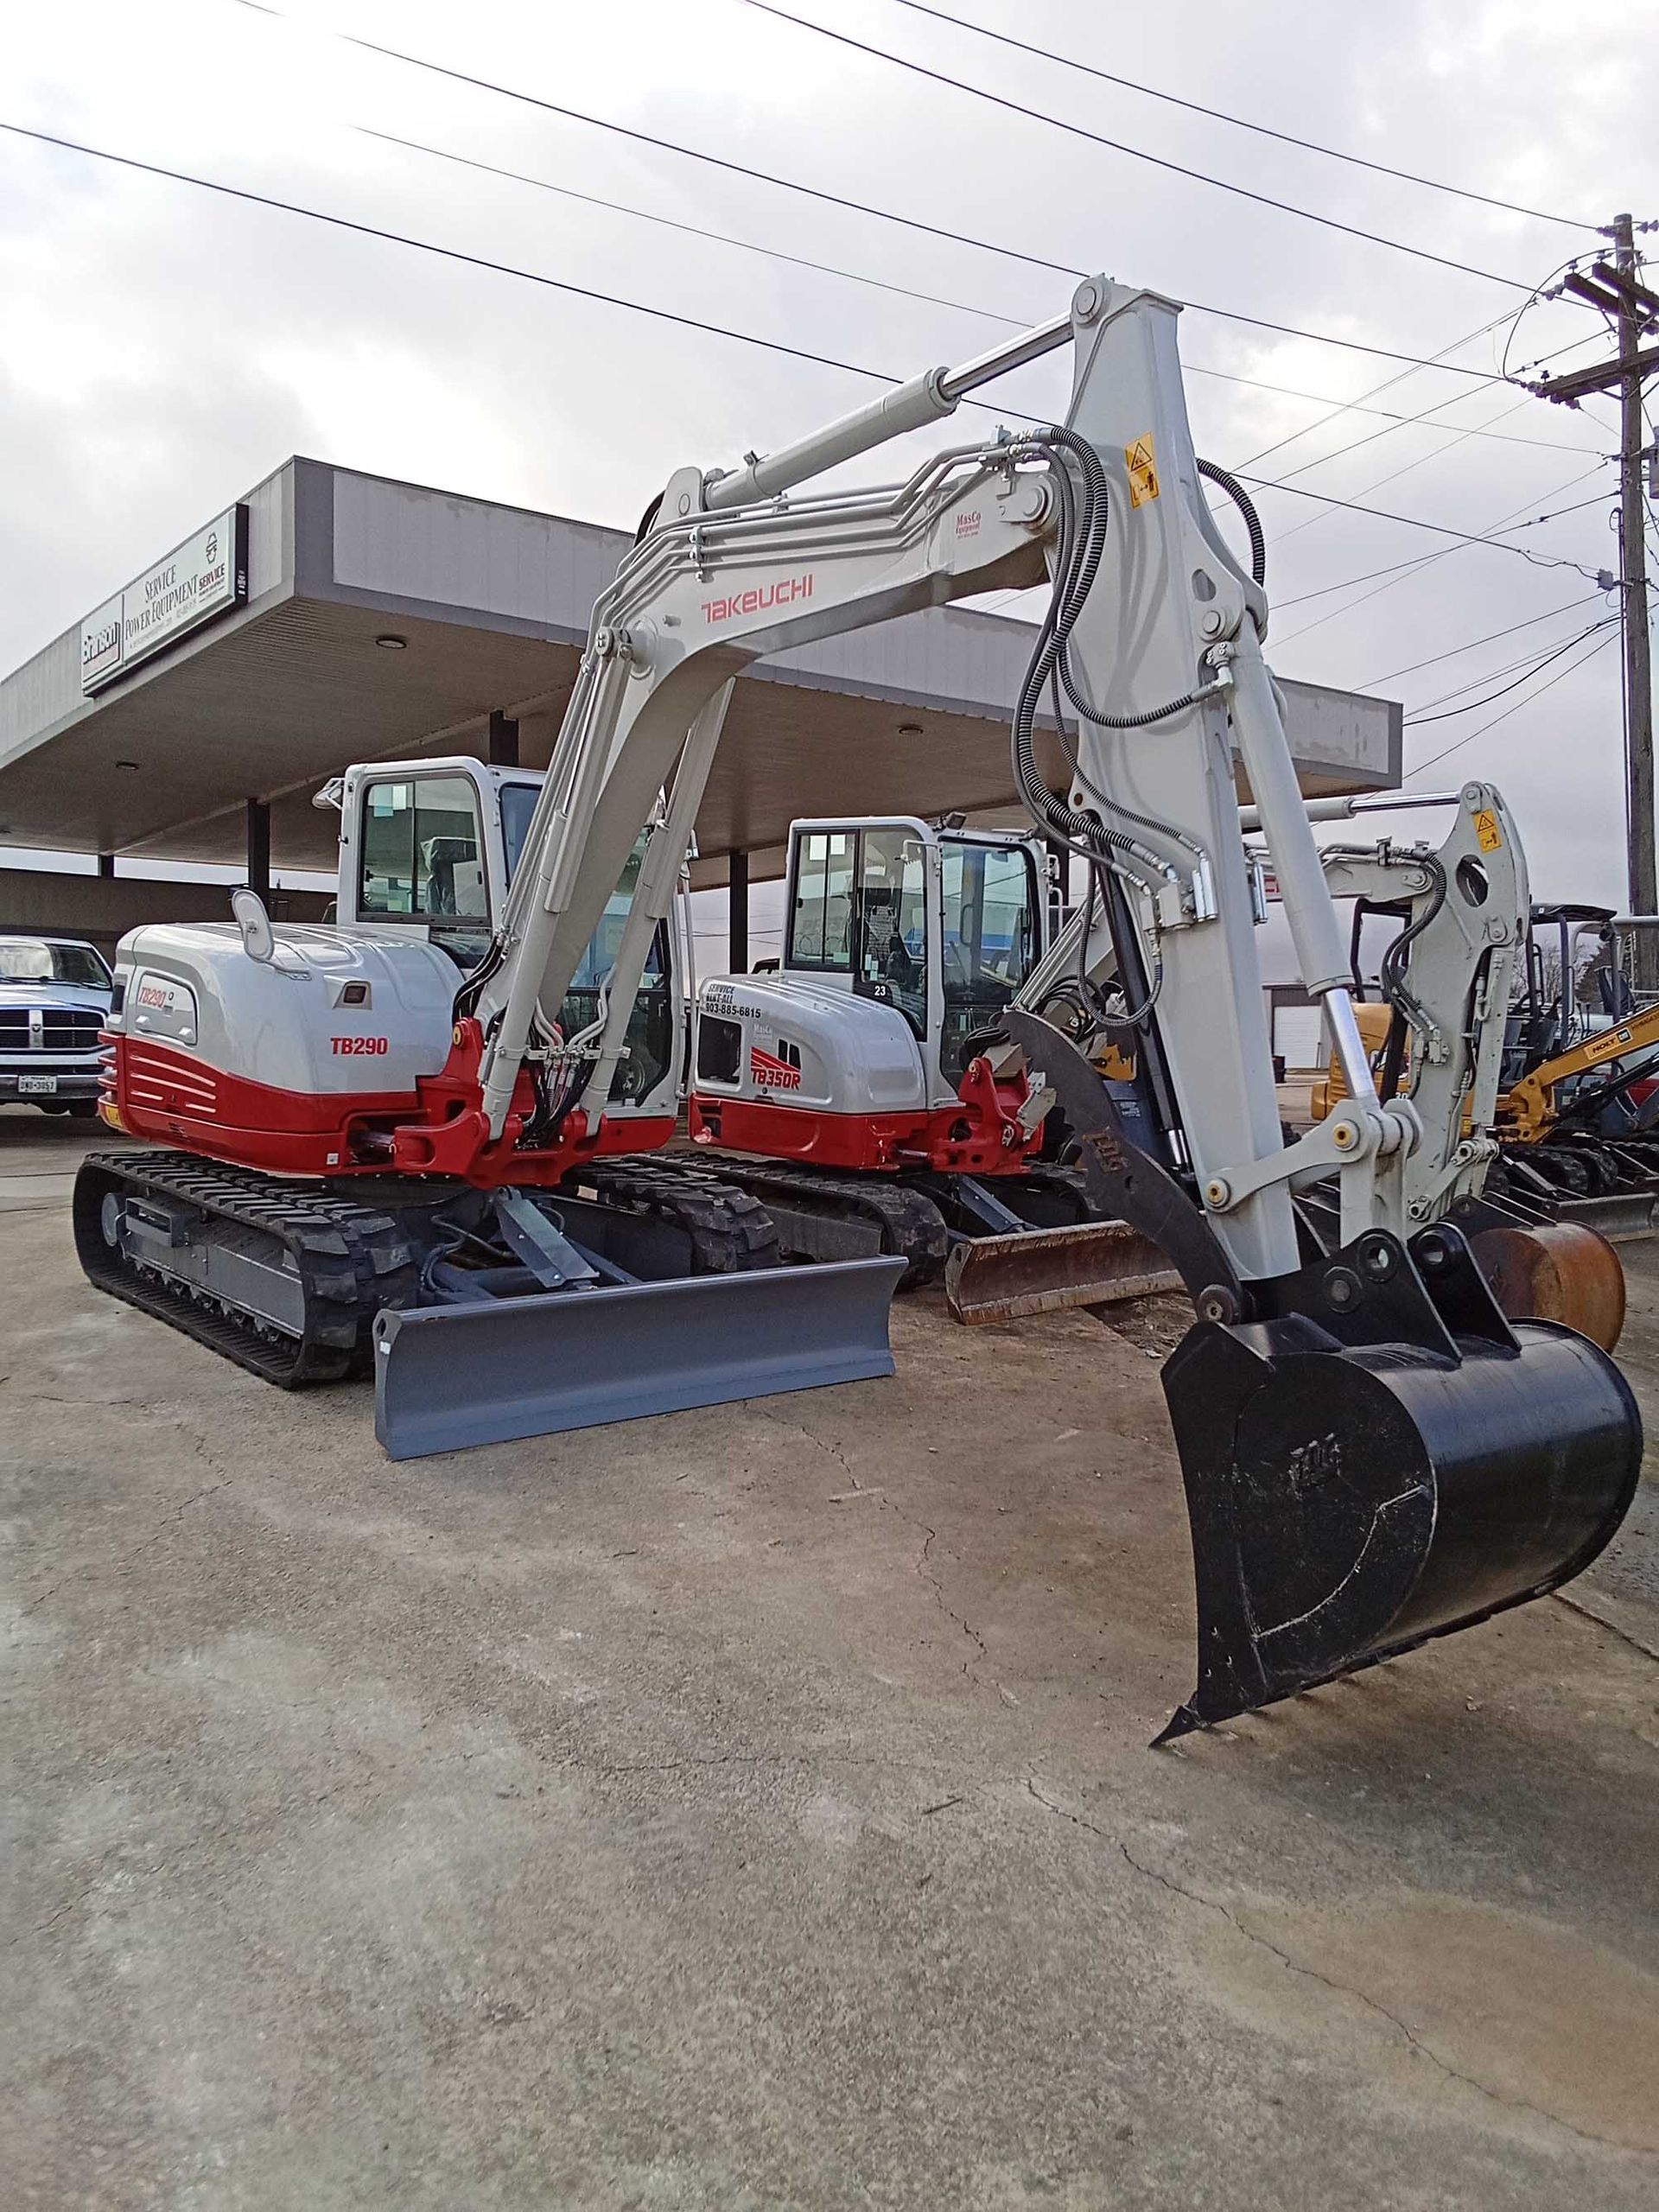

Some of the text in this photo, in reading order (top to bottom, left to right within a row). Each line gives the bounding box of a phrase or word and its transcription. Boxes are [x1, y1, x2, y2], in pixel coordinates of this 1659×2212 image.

[199, 563, 226, 591] SERVICE
[125, 608, 151, 640] POWER
[151, 574, 198, 622] EQUIPMENT
[701, 574, 815, 623] TAKEUCHI
[138, 986, 167, 1008] TB290
[708, 983, 735, 994] SERVICE
[874, 985, 887, 996] 23
[705, 1002, 761, 1018] 903-885-6815
[331, 1037, 389, 1056] TB290
[751, 1069, 802, 1090] TB350R
